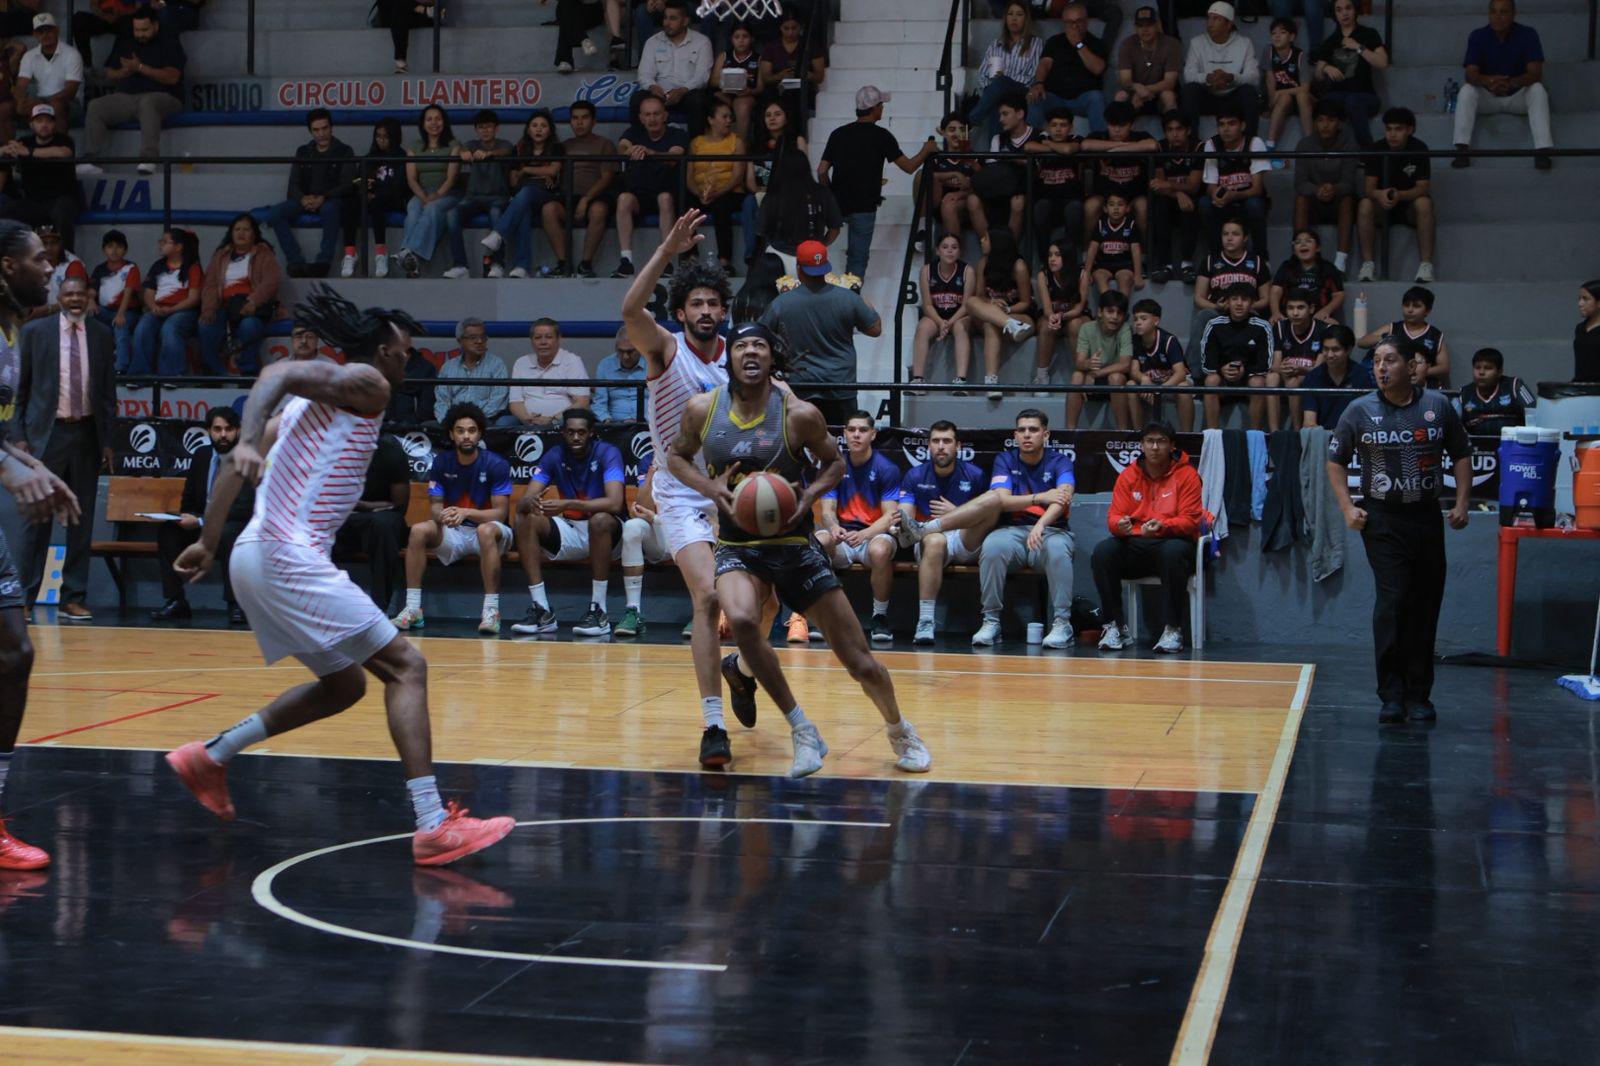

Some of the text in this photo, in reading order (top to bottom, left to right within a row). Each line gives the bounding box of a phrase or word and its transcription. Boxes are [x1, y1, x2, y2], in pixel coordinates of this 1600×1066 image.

[192, 83, 262, 111] STUDIO
[278, 79, 541, 107] CIRCULO LLANTERO
[904, 283, 918, 304] B
[122, 456, 160, 469] MEGA
[1393, 476, 1440, 491] MEGA
